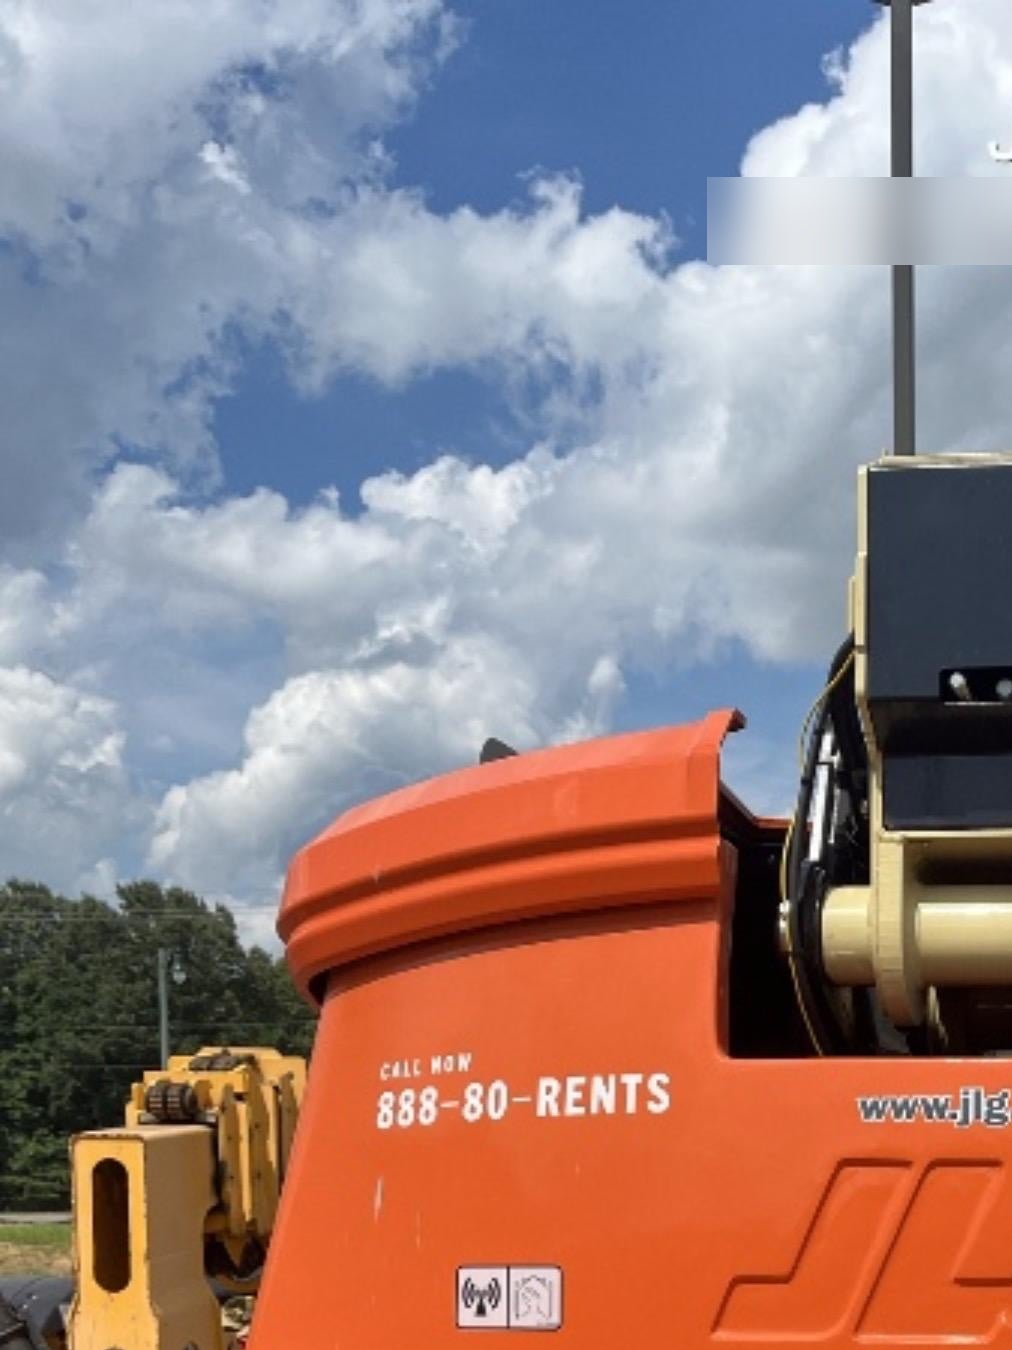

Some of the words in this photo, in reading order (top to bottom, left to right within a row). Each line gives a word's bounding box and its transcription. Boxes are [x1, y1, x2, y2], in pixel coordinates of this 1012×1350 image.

[380, 1059, 421, 1081] CALL
[431, 1052, 472, 1075] NOW
[376, 1073, 671, 1130] 888-80-RENTS
